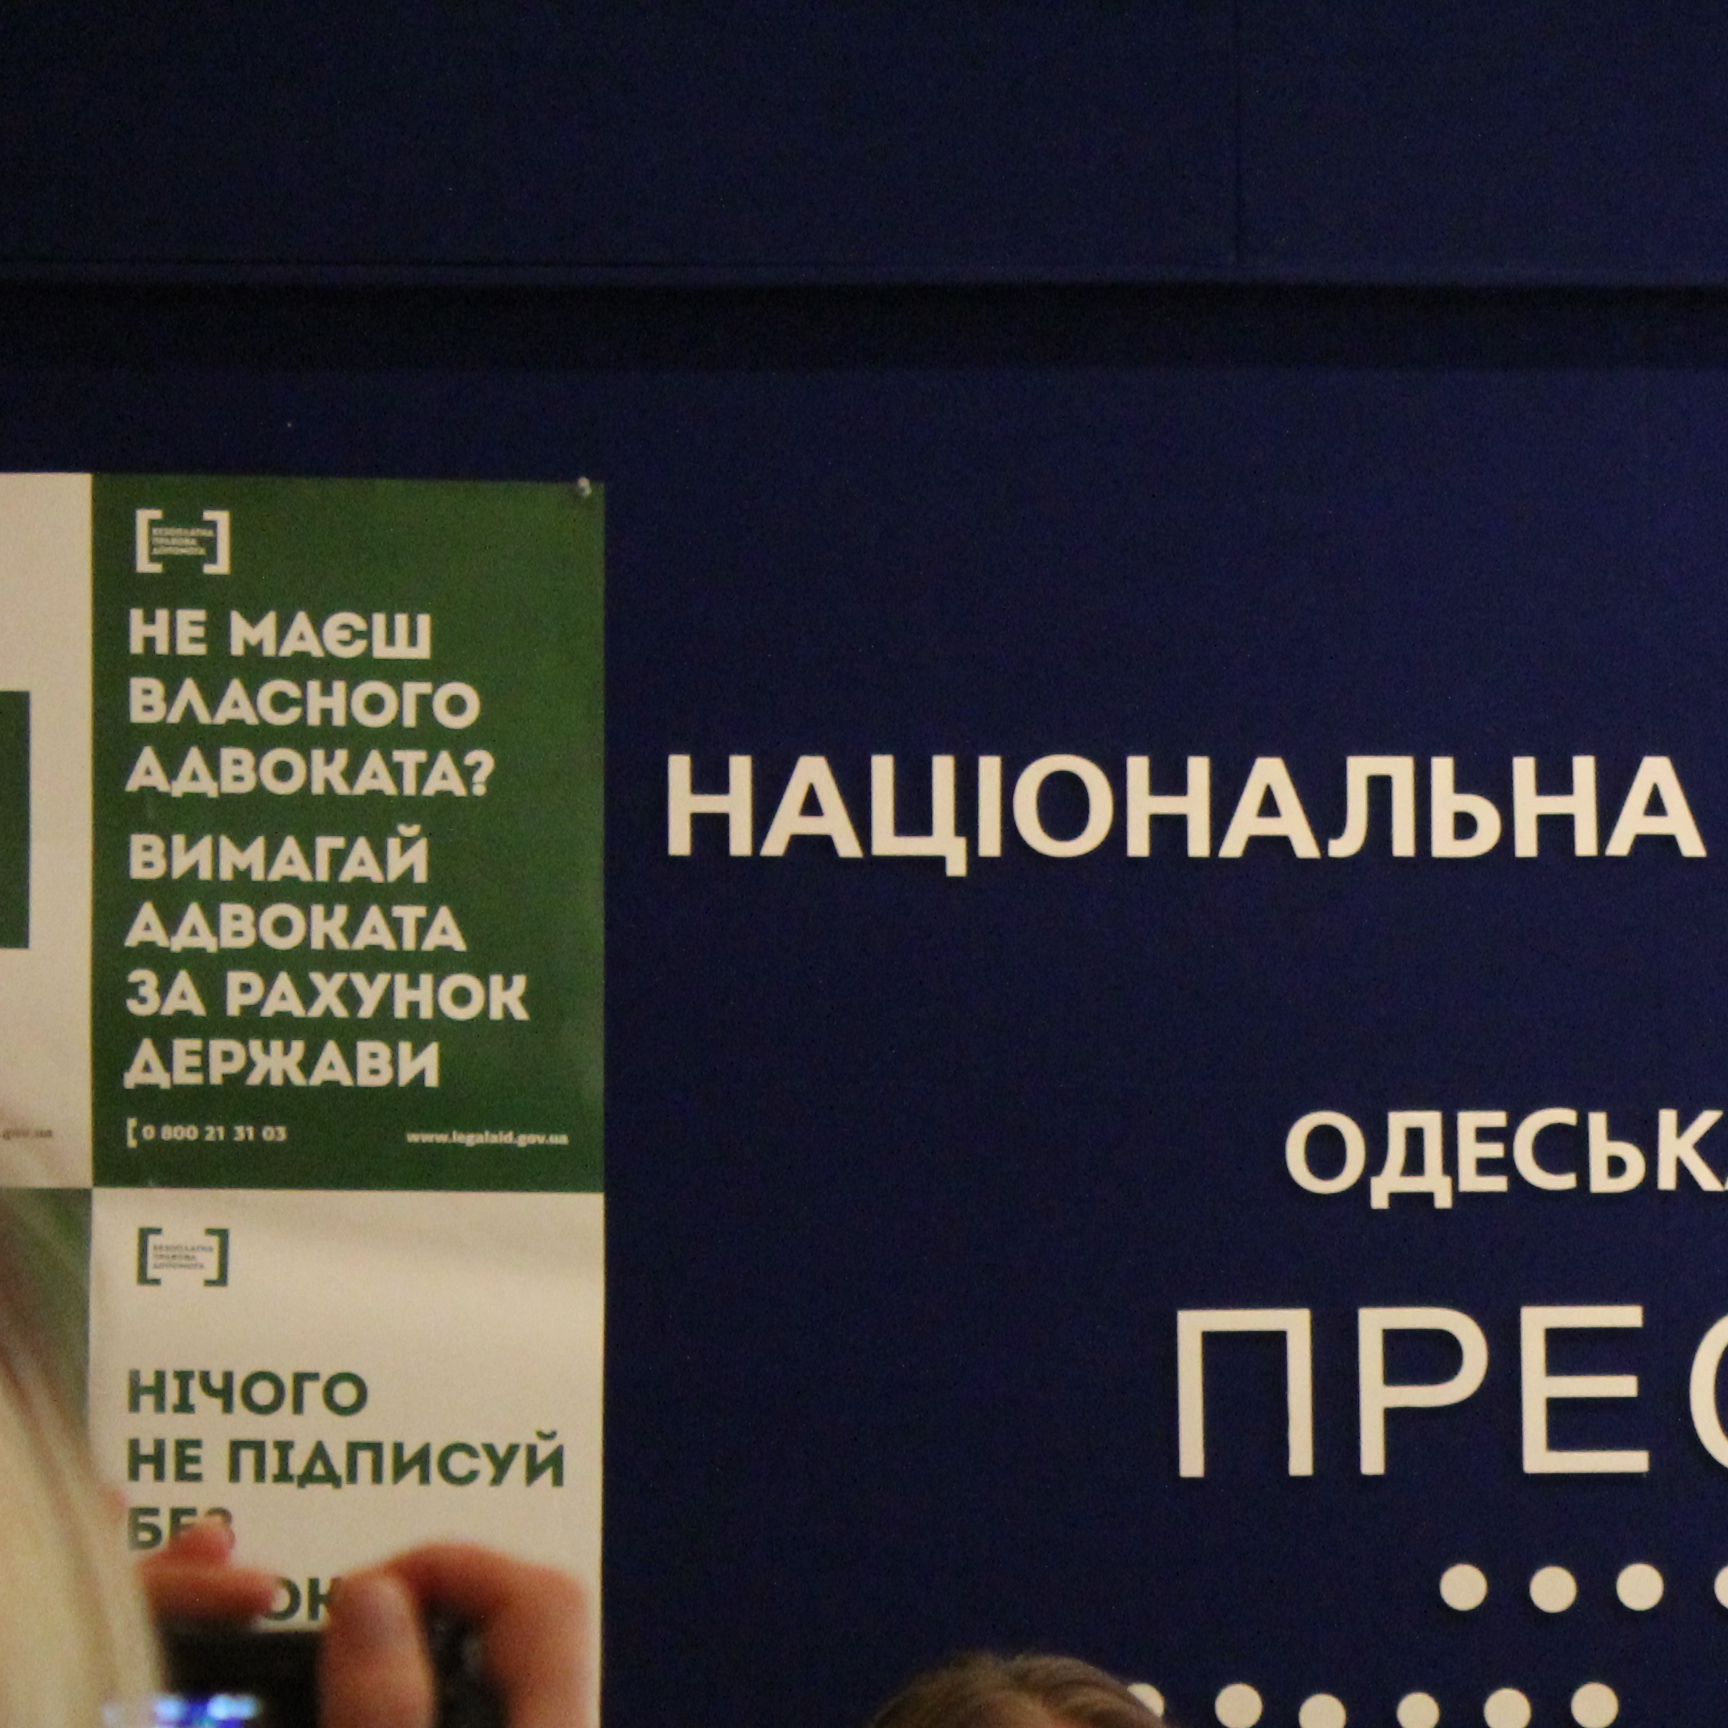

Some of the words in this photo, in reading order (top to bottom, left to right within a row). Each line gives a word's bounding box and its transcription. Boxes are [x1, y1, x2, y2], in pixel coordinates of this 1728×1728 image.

[128, 607, 208, 656] НЕ
[229, 609, 432, 661] МАЄШ
[128, 676, 481, 730] ВЛАСНОГО
[125, 745, 496, 799] АДВОКАТА?
[667, 753, 1706, 876] НАЦІОНАЛЬНА
[128, 823, 429, 884] ВИМАГАЙ
[124, 900, 468, 954] АДВОКАТА
[125, 968, 206, 1017] ЗА
[225, 970, 530, 1022] РАХУНОК
[123, 1037, 440, 1090] ДЕРЖАВИ
[142, 1124, 156, 1140] 0
[161, 1124, 199, 1141] 800
[205, 1125, 225, 1141] 21
[233, 1125, 254, 1141] 31
[261, 1126, 288, 1142] 03
[406, 1130, 569, 1147] www.legalaid.gov.ua
[127, 1368, 369, 1418] НІЧОГО
[127, 1436, 204, 1484] НЕ
[227, 1429, 565, 1491] ПІДПИСУЙ
